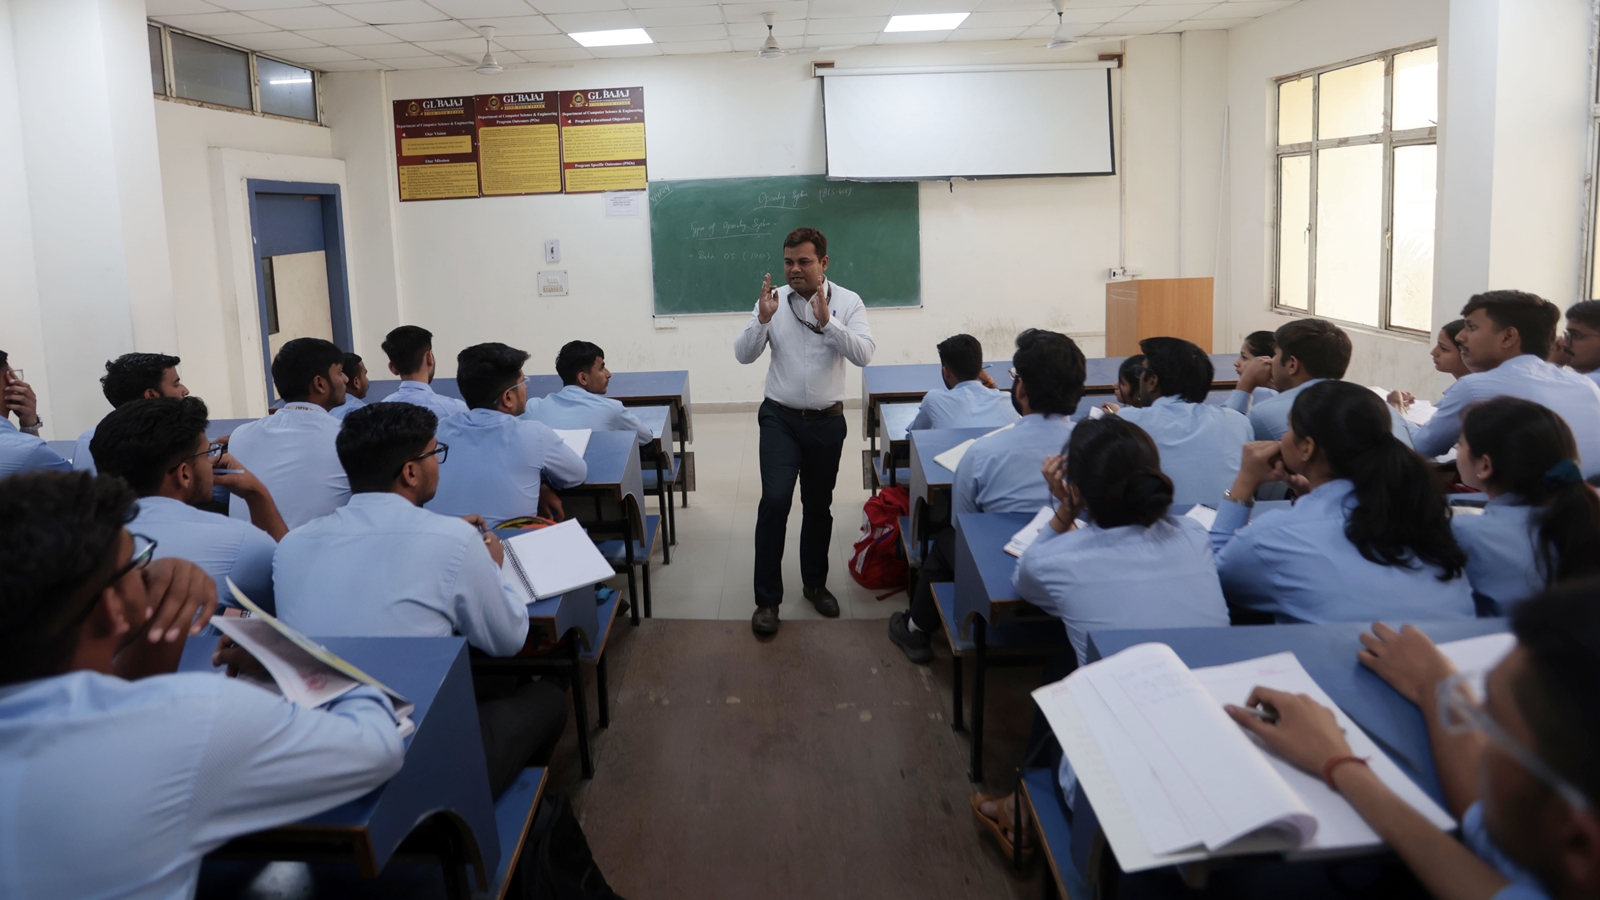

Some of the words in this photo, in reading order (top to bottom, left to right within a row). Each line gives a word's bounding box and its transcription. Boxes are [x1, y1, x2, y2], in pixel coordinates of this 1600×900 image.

[503, 95, 517, 103] GL
[517, 93, 544, 102] BAJAJ
[588, 92, 602, 100] GL
[603, 90, 630, 98] BAJAJ
[422, 101, 436, 109] GL
[437, 99, 463, 107] BAJAJ
[709, 222, 716, 237] of
